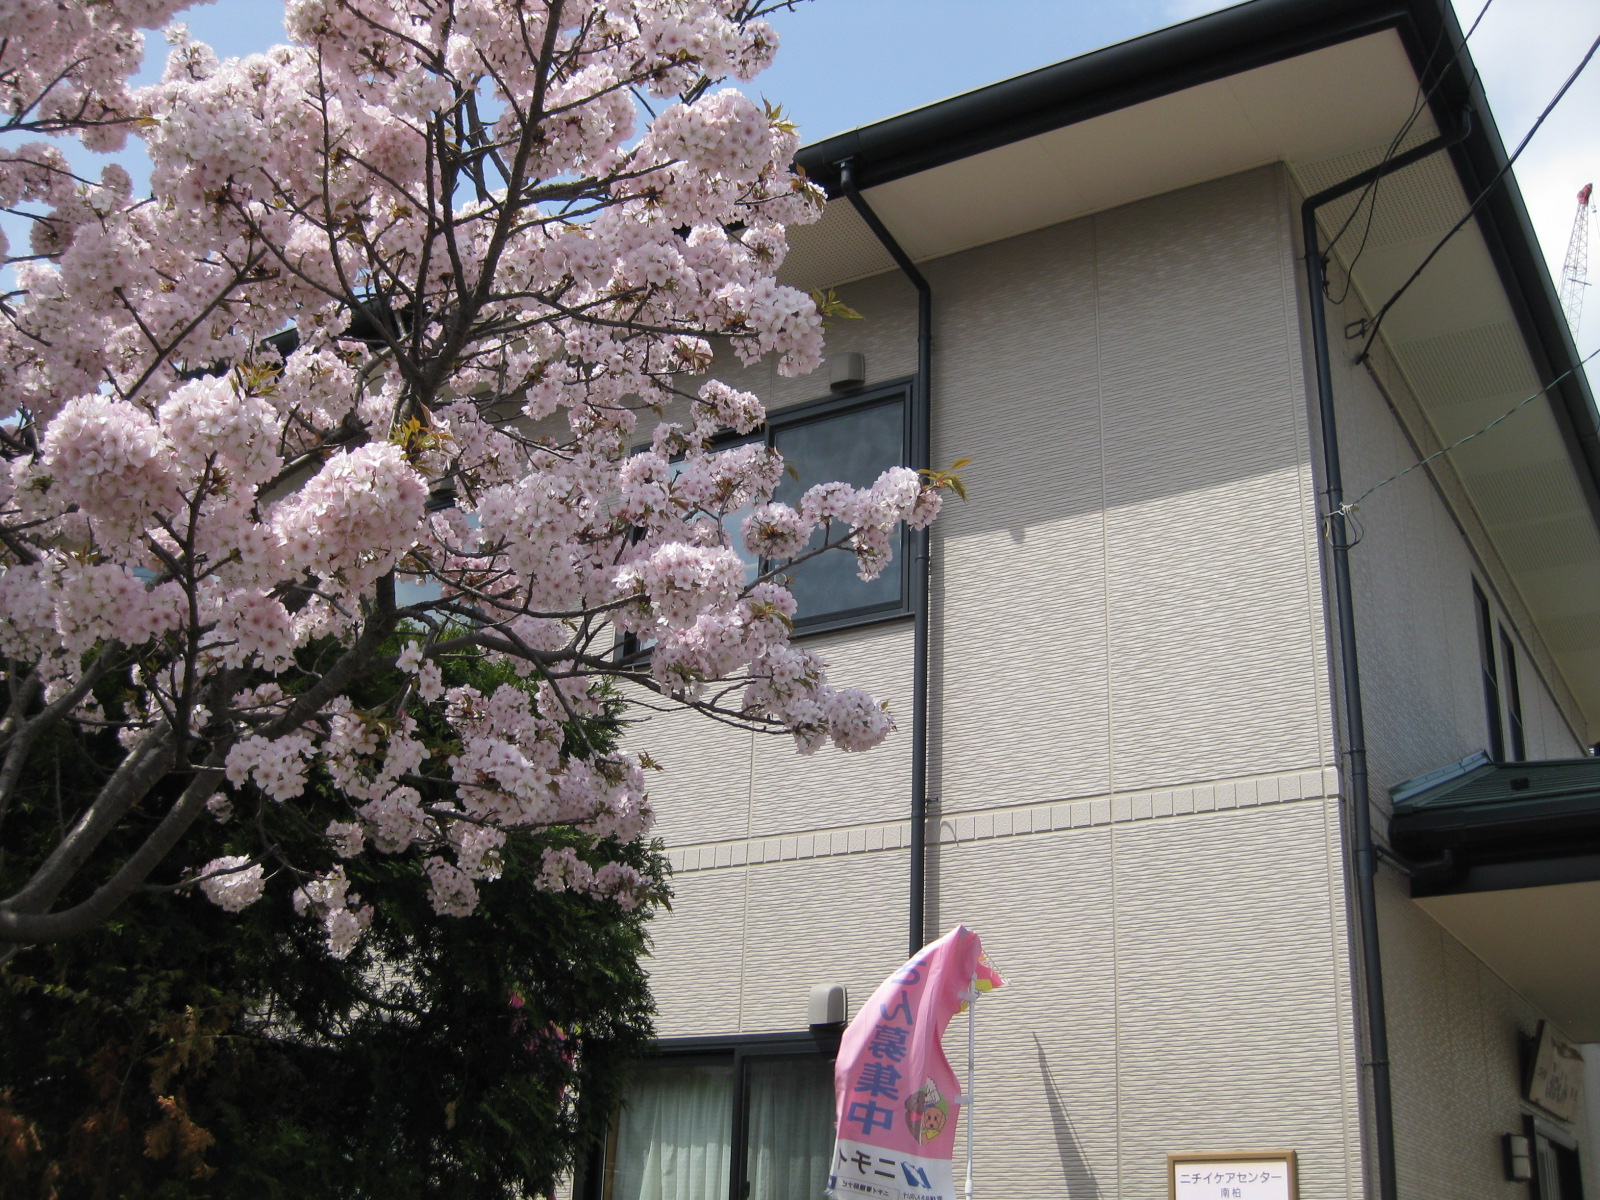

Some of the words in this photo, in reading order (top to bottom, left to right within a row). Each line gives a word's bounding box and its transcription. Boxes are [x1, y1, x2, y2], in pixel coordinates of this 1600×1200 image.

[1180, 1171, 1282, 1184] ニチイケアセンター
[1220, 1187, 1241, 1198] 南柏
